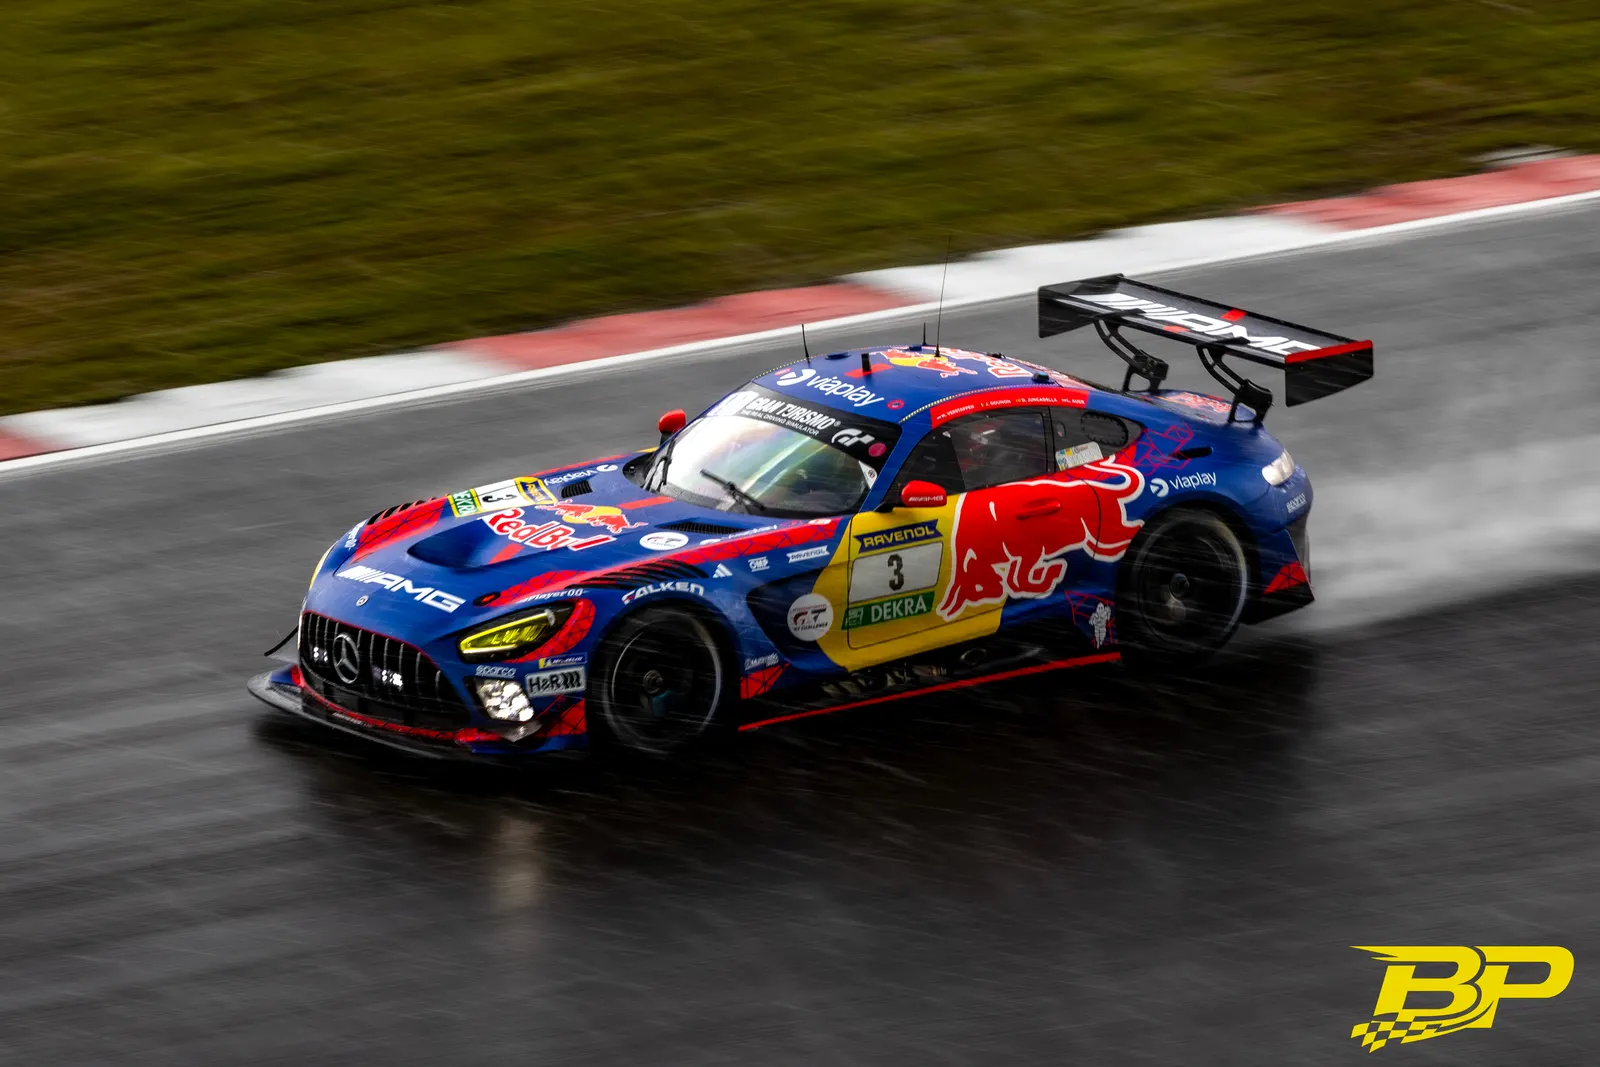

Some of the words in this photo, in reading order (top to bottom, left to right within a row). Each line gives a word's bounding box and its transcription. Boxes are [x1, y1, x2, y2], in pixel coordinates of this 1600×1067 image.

[806, 376, 884, 407] viaplay
[763, 413, 787, 424] DRIVING
[785, 420, 819, 436] SIMULATOR
[1170, 471, 1217, 491] viaplay
[486, 508, 555, 546] Red
[528, 522, 616, 550] Bull
[863, 525, 935, 549] RAVENOL
[749, 558, 769, 570] OMP
[887, 554, 905, 591] 3
[372, 573, 467, 613] AMG
[622, 581, 704, 605] FALKEN
[871, 595, 927, 623] DEKRA
[476, 664, 517, 677] sparco
